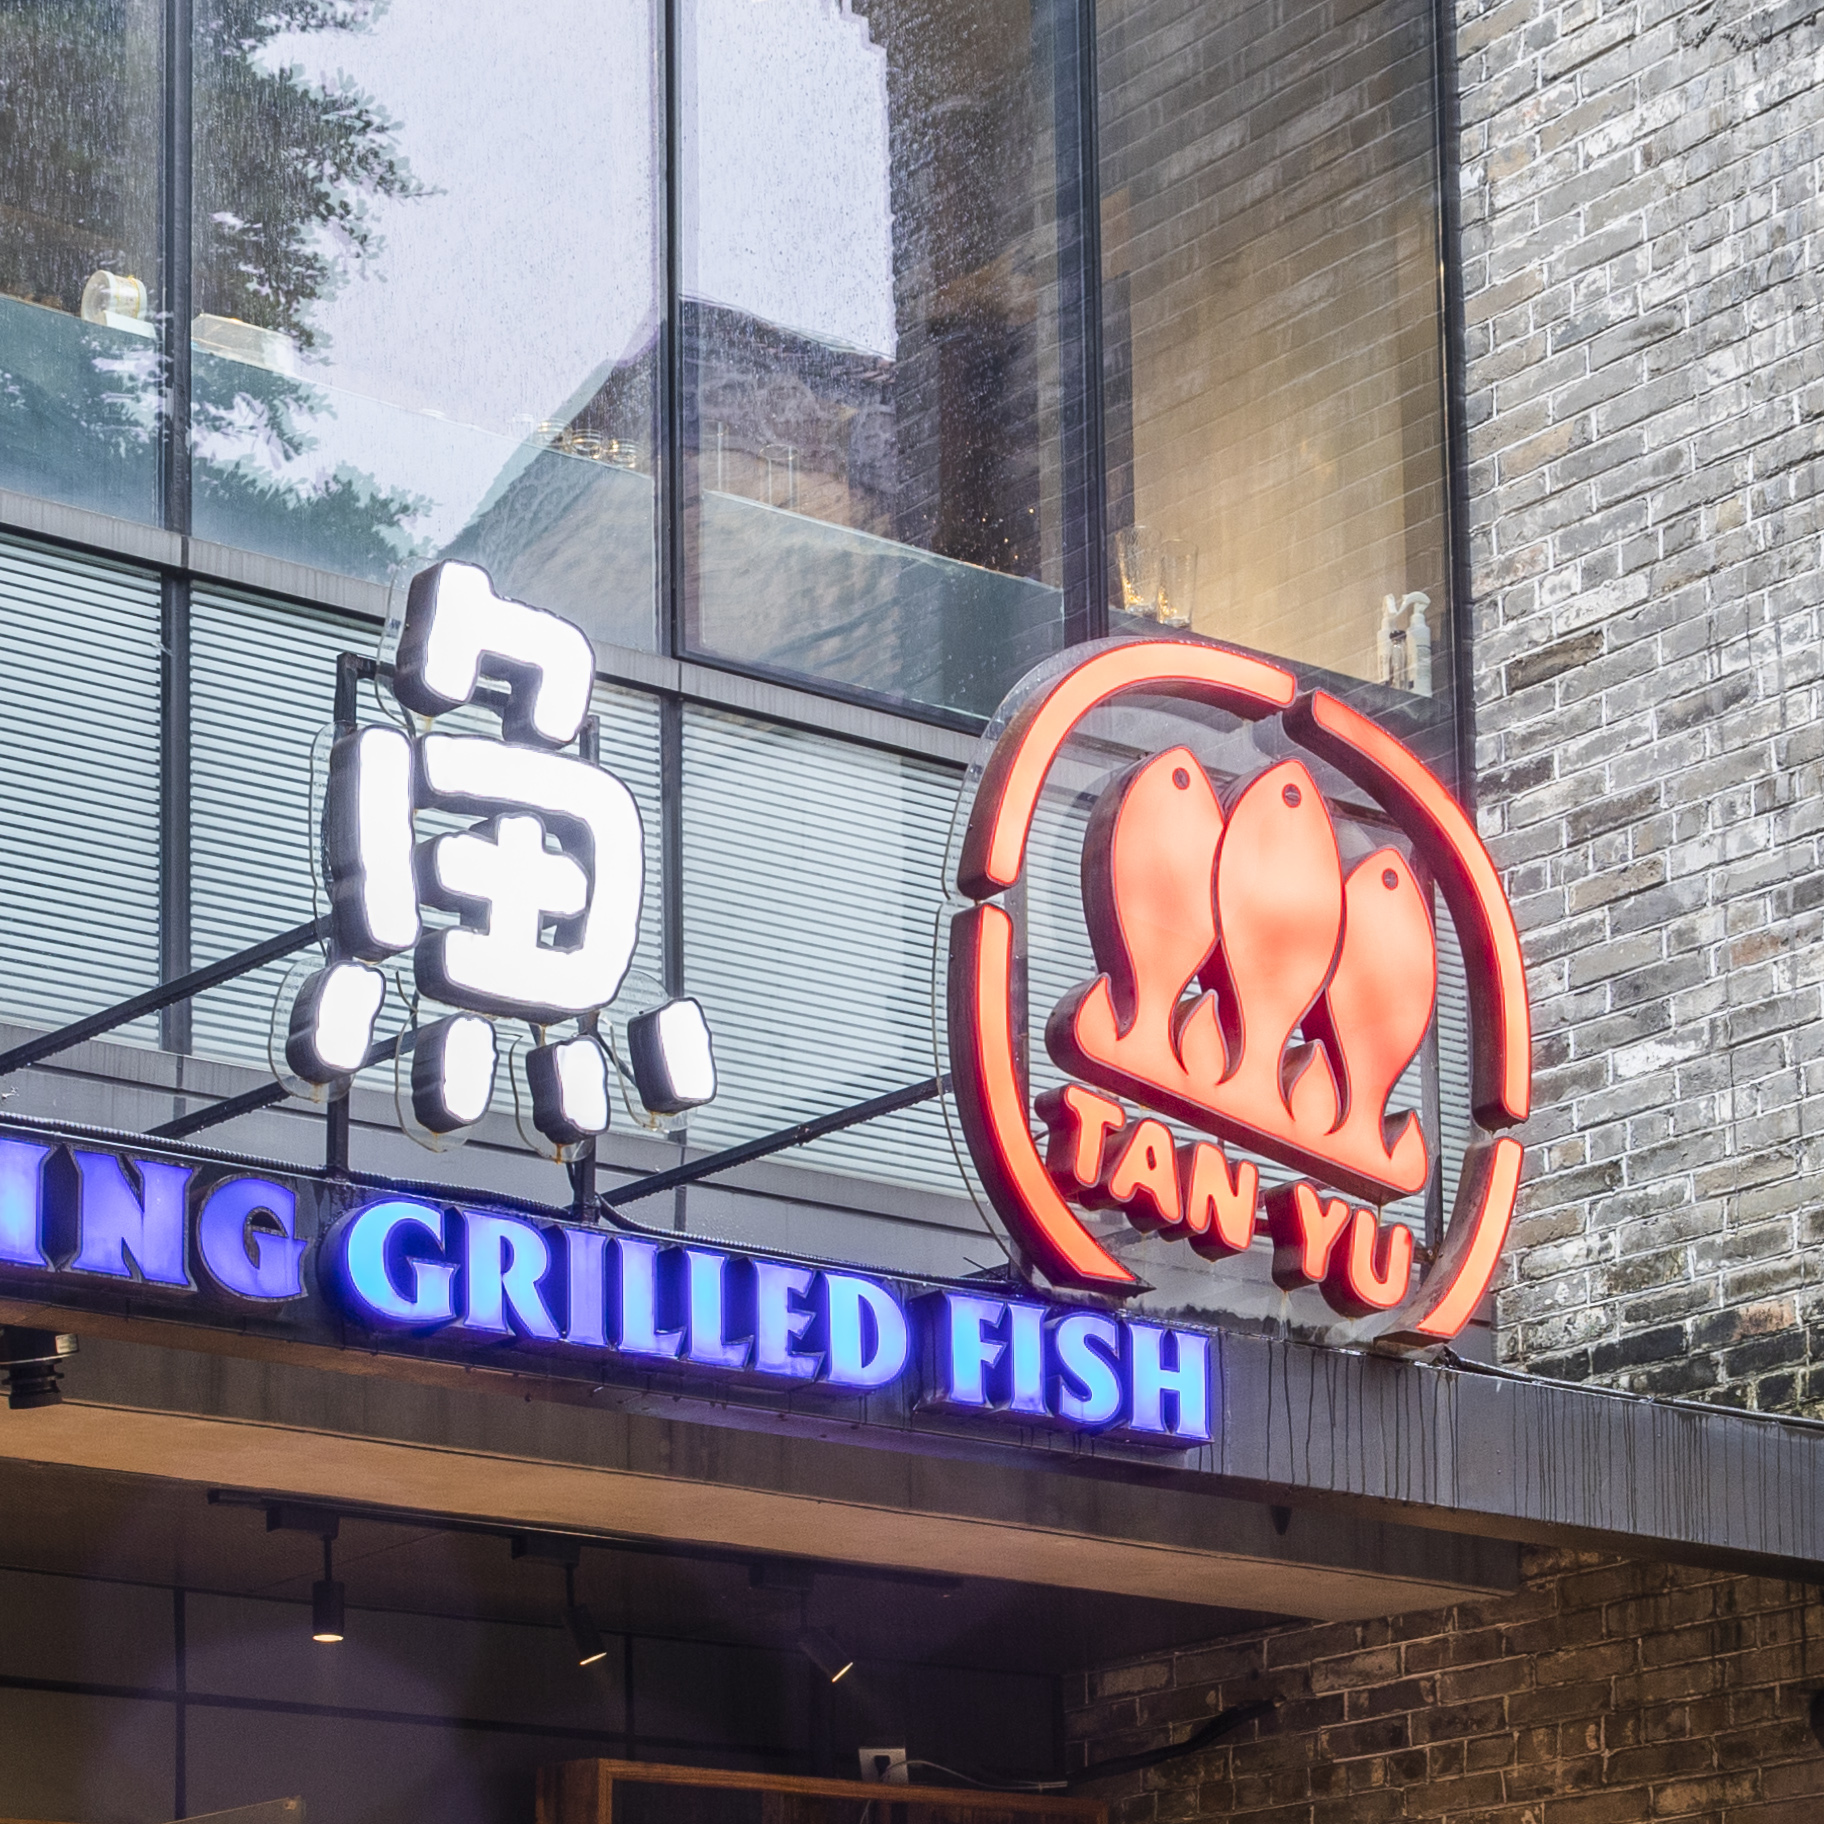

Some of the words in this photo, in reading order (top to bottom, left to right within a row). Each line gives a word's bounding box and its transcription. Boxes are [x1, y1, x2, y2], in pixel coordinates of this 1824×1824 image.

[1042, 1083, 1260, 1257] TAN
[1274, 1180, 1414, 1312] YU
[340, 1198, 910, 1392] GRILLED
[942, 1291, 1216, 1448] FISH
